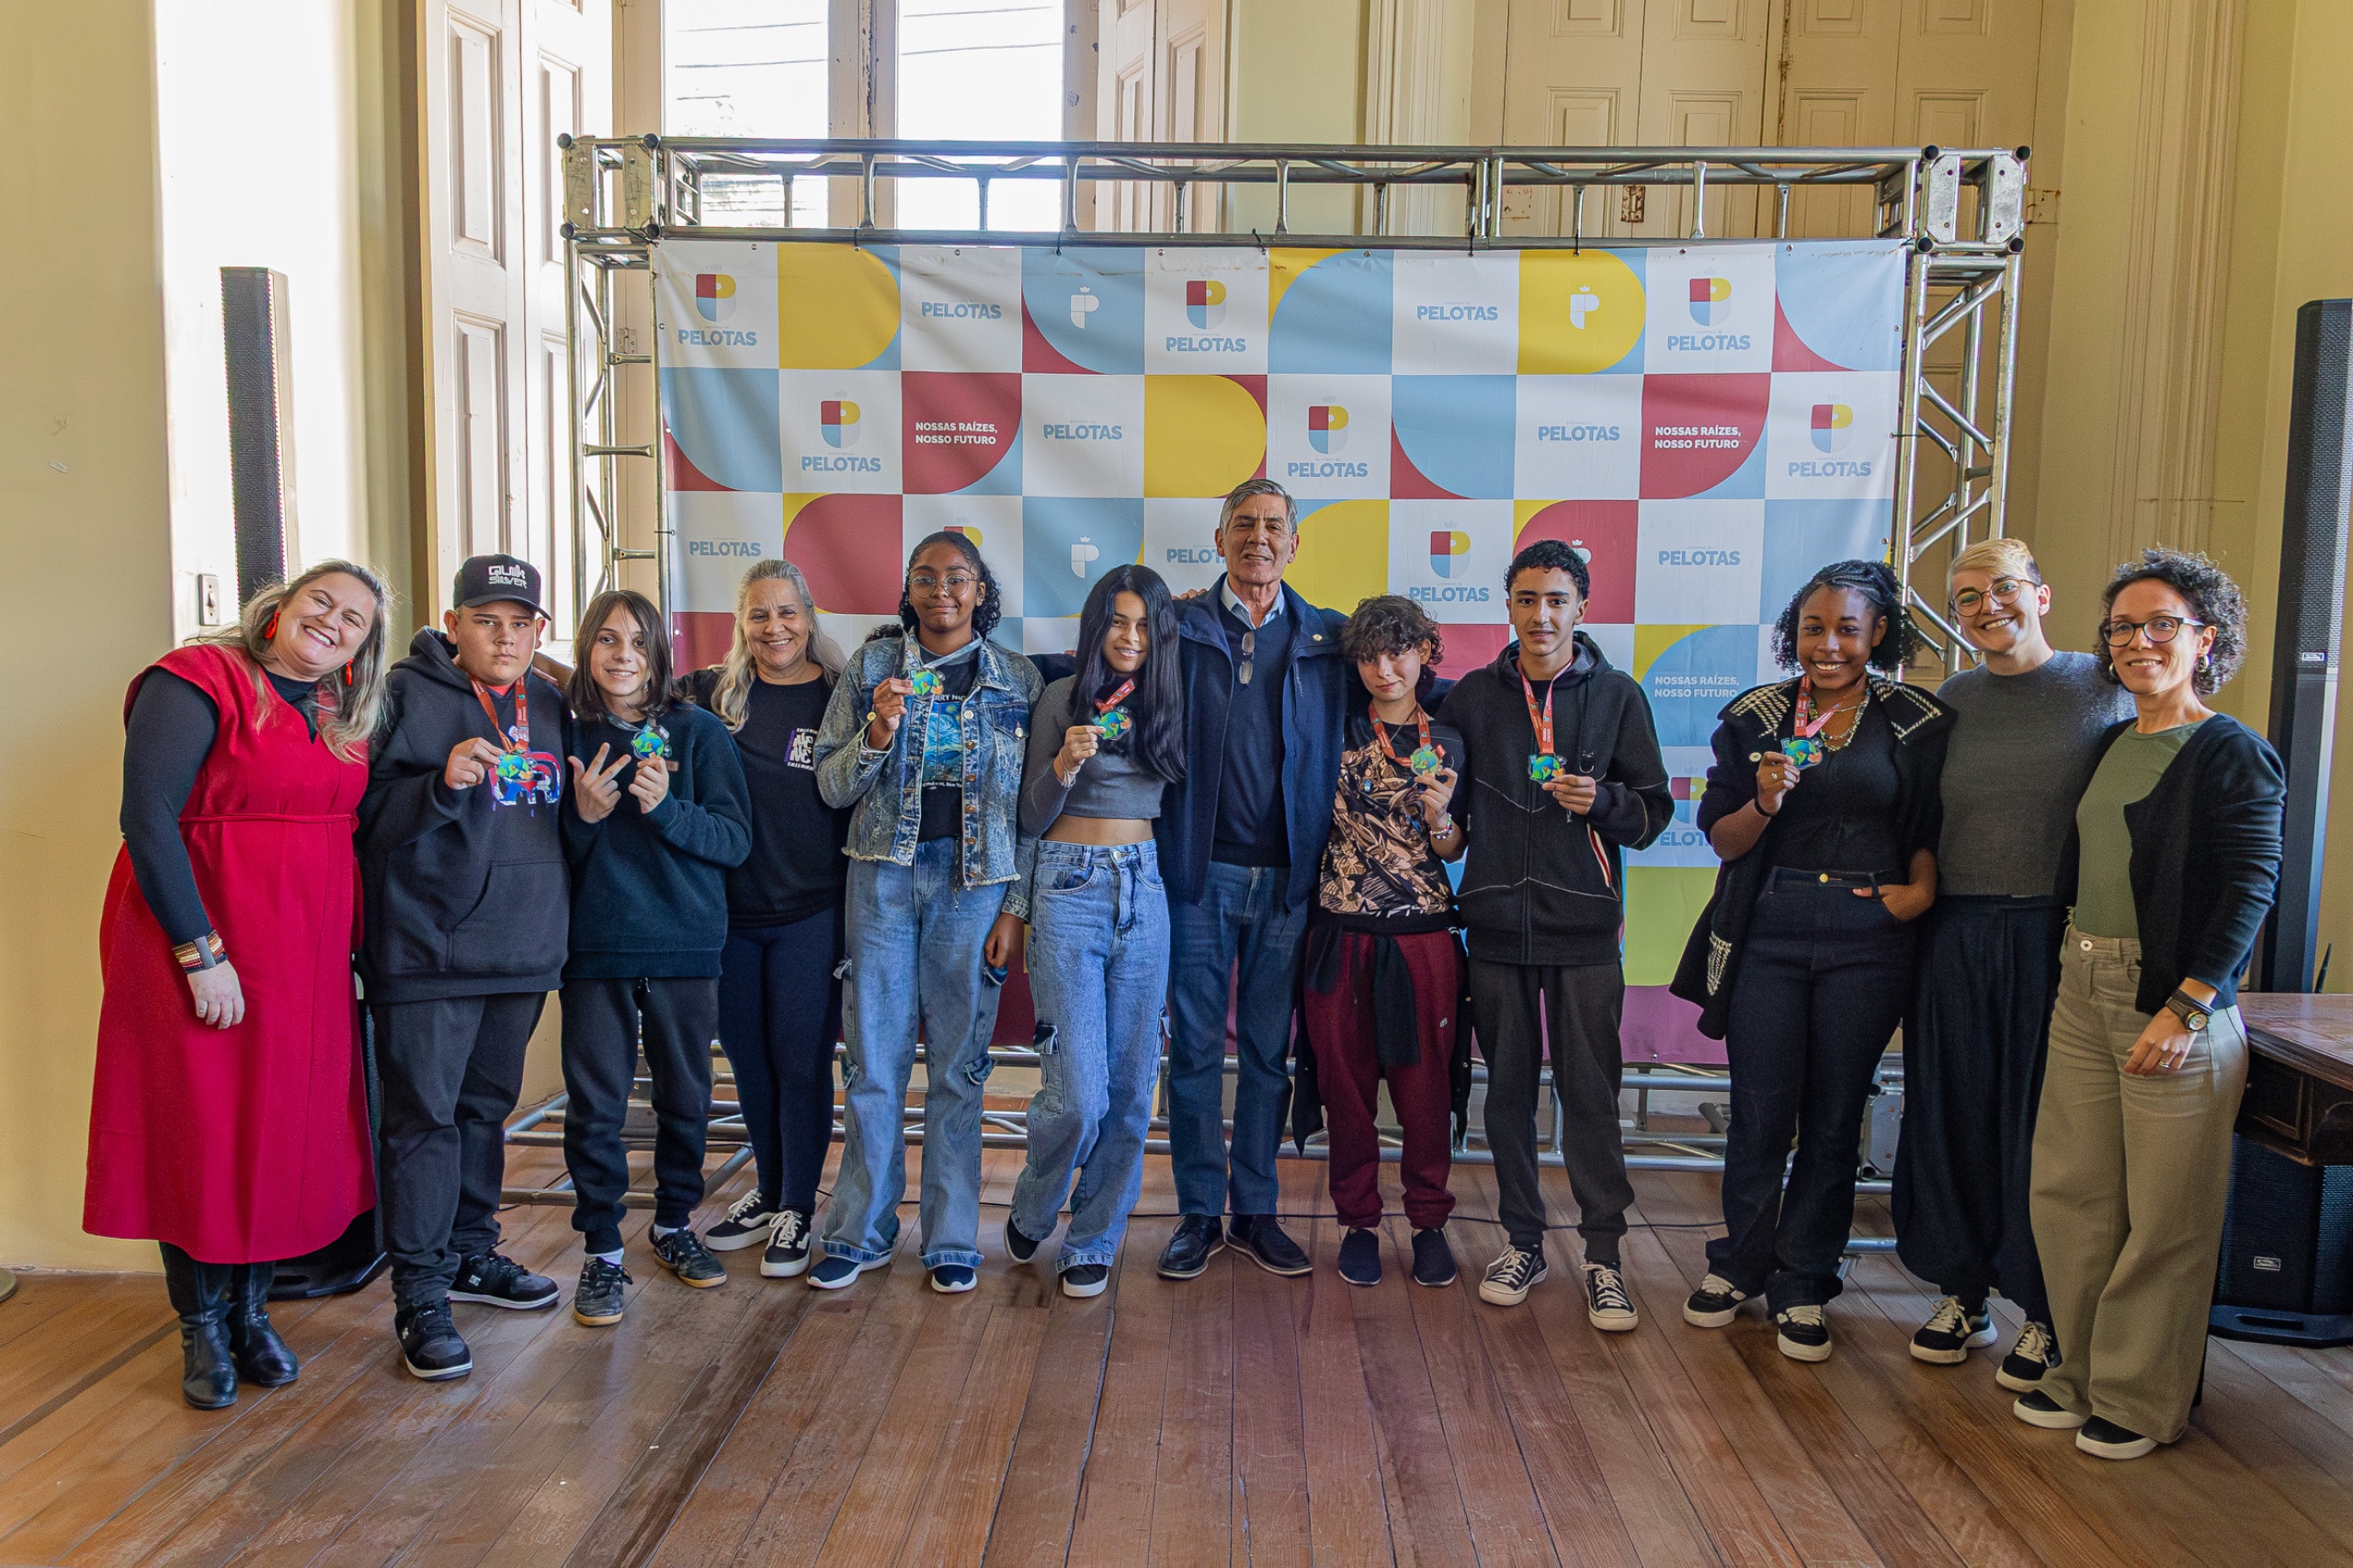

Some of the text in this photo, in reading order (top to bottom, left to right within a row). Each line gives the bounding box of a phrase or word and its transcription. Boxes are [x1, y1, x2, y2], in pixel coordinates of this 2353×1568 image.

[921, 301, 1001, 320] PELOTAS
[1416, 305, 1498, 321] PELOTAS
[678, 329, 757, 347] PELOTAS
[1165, 336, 1246, 353] PELOTAS
[1667, 335, 1750, 351] PELOTAS
[915, 421, 997, 434] NOSSAS RAÍZES,
[1043, 424, 1122, 440] PELOTAS
[1538, 426, 1620, 441] PELOTAS
[1655, 425, 1741, 437] NOSSAS RAÍZES,
[915, 435, 996, 445] NOSSO FUTURO
[1654, 439, 1739, 449] NOSSO FUTURO
[801, 456, 881, 473] PELOTAS
[1288, 461, 1369, 478] PELOTAS
[1788, 461, 1871, 478] PELOTAS
[689, 541, 762, 557] PELOTAS
[1166, 549, 1226, 563] PELOT
[1657, 551, 1741, 566] PELOTAS
[1409, 586, 1490, 603] PELOTAS
[1654, 674, 1740, 687] NOSSAS RAÍZES,
[1654, 689, 1737, 698] NOSSO FUTURO
[1659, 831, 1708, 846] ELOT
